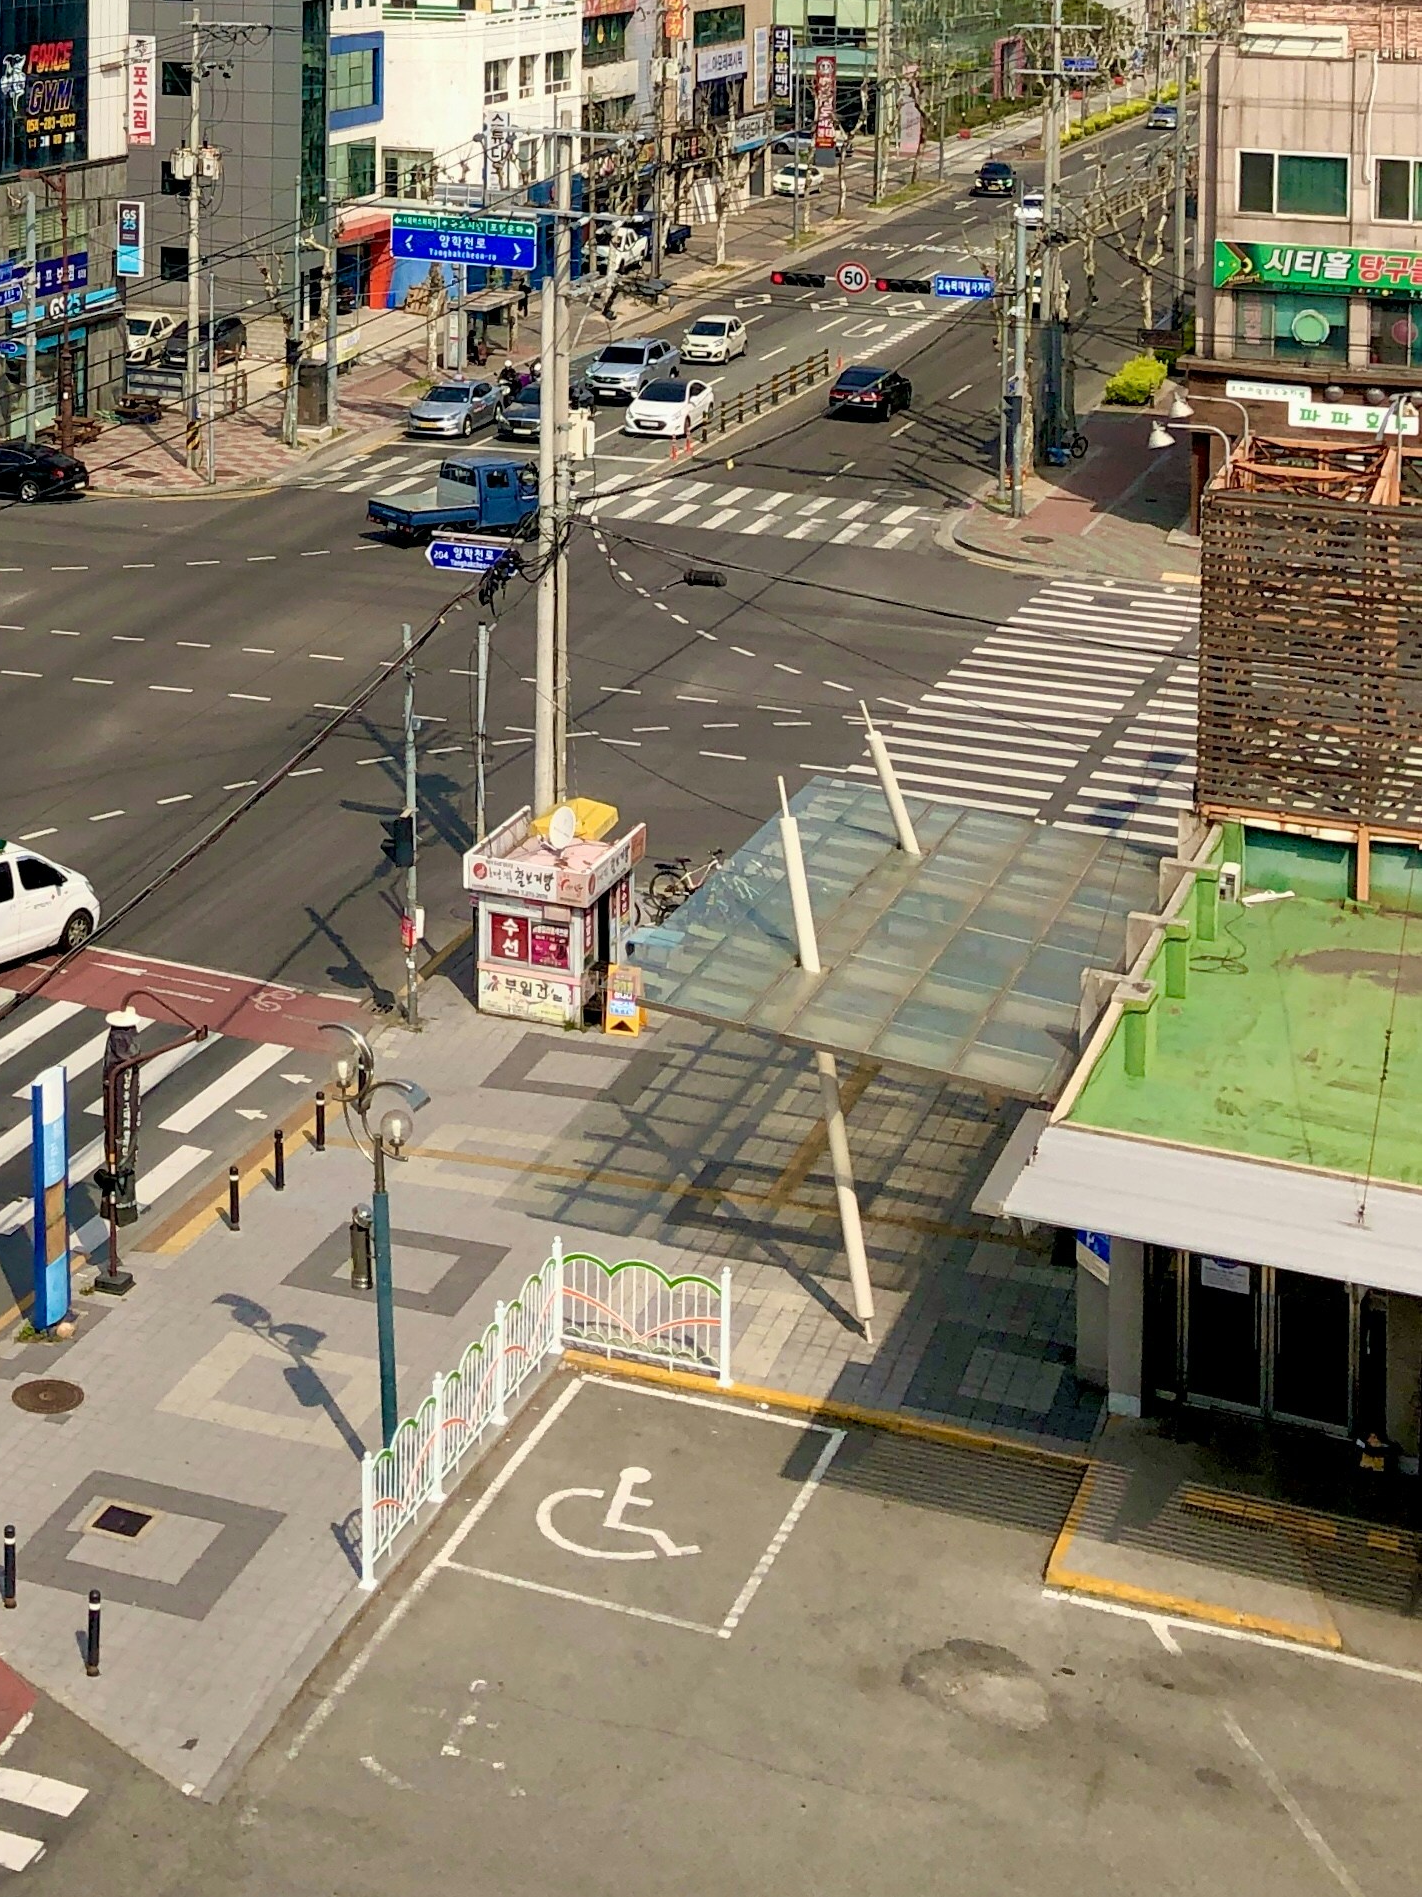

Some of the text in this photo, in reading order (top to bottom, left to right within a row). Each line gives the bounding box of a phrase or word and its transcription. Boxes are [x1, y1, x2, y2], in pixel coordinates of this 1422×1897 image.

[27, 40, 74, 74] FORCE
[28, 77, 74, 115] GYM
[133, 66, 148, 129] 포스짐
[122, 209, 137, 220] GS
[122, 219, 137, 231] 25
[439, 234, 487, 249] 양학천로
[1264, 249, 1354, 280] 시티홀
[843, 270, 864, 286] 50
[433, 547, 494, 562] 204 양학천로
[501, 918, 520, 958] 수선
